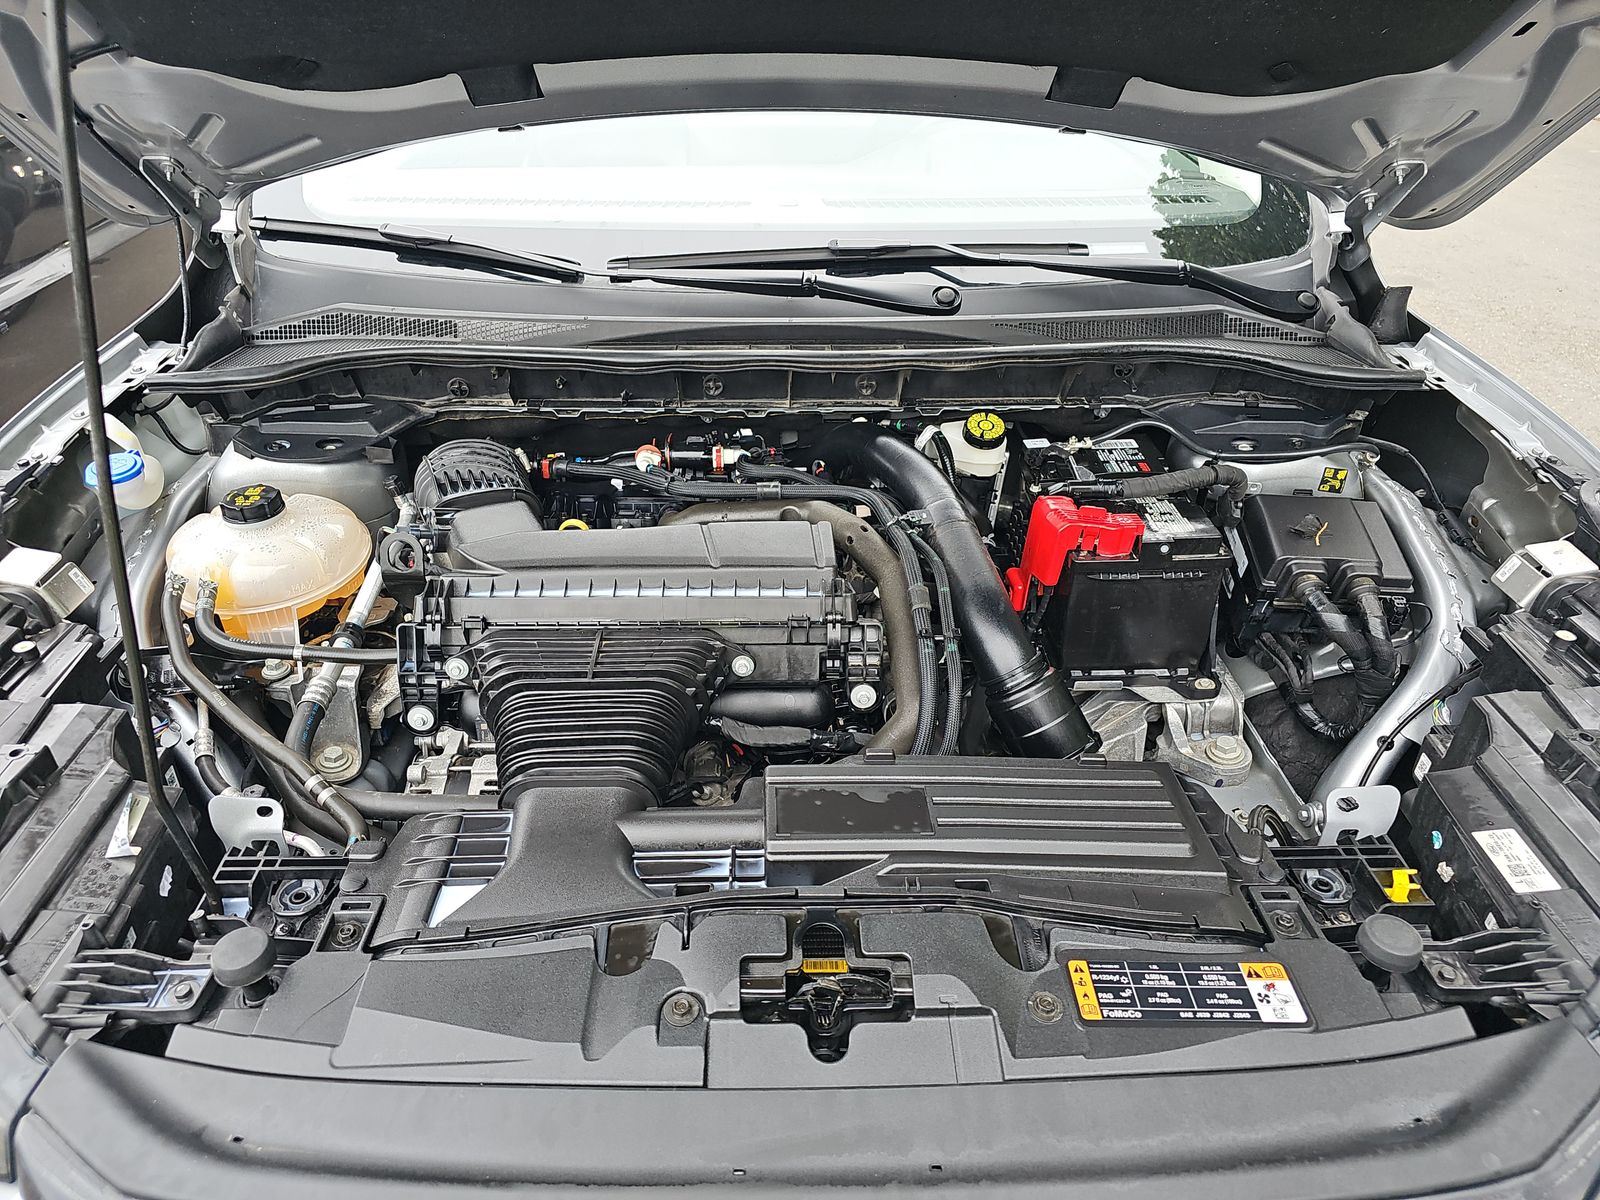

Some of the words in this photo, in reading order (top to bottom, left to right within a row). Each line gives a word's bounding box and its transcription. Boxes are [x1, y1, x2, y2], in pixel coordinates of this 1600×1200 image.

[290, 579, 316, 595] MAX
[1091, 973, 1120, 982] R-1234yf
[1102, 1009, 1142, 1018] FoMoCo
